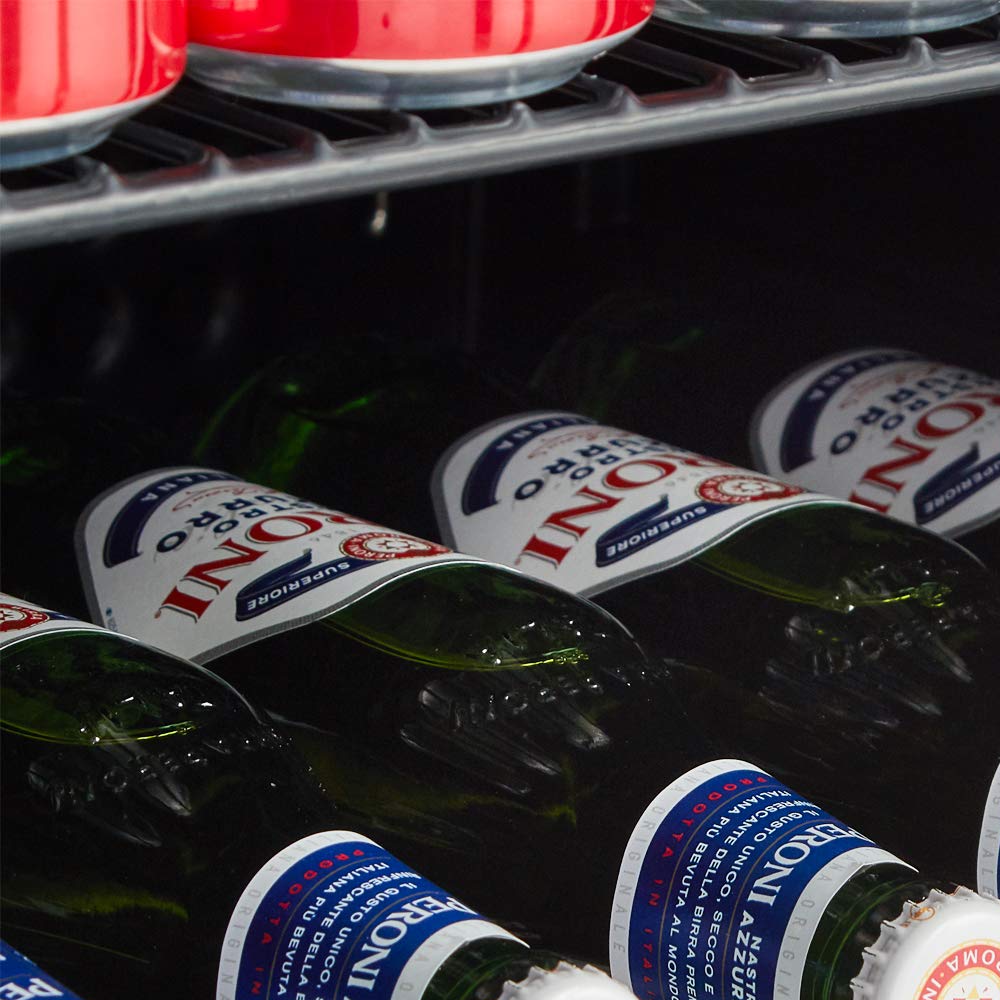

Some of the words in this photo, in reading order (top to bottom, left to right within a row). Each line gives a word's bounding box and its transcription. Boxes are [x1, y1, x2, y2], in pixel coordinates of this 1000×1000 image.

[605, 504, 706, 557] SUPERIORE
[247, 561, 350, 610] SUPERIORE
[662, 776, 767, 858] PRODOTTA
[728, 790, 792, 814] ITALIANA
[754, 812, 802, 842] GUSTO
[324, 862, 389, 894] ITALIANA
[676, 842, 708, 907] BEVUTA
[698, 844, 728, 899] DELLA
[747, 824, 878, 907] PERONI
[351, 886, 399, 923] GUSTO
[649, 879, 663, 906] IN
[347, 896, 478, 991] PERONI
[669, 915, 681, 936] AL
[686, 906, 704, 960] BIRRA
[704, 911, 723, 980] SECCO
[277, 926, 304, 996] BEVUTA
[299, 930, 324, 986] DELLA
[704, 984, 714, 995] E
